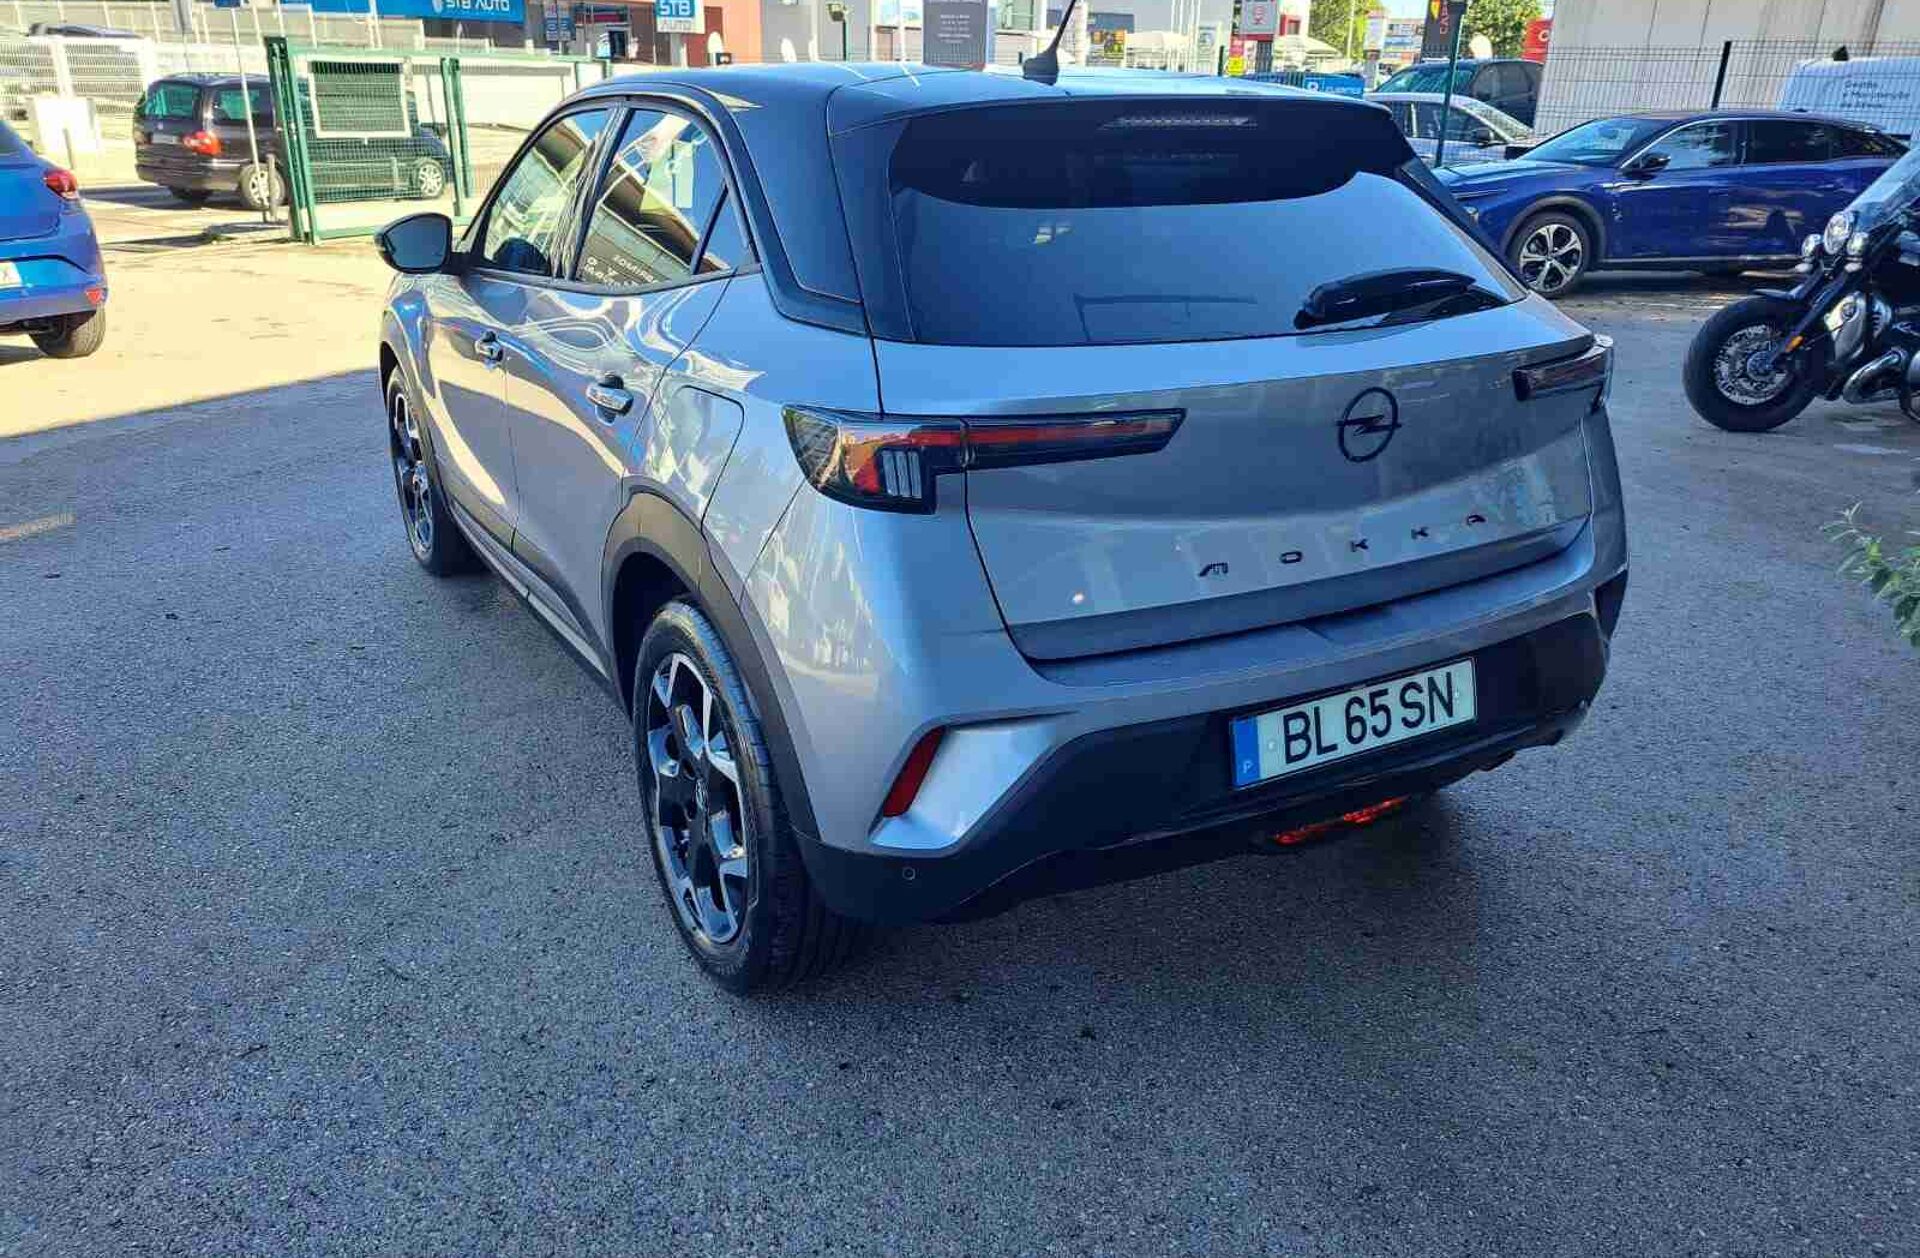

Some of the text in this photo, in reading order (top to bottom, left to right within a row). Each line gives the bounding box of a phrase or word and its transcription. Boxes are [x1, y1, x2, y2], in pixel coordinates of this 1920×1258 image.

[475, 0, 510, 12] AUTO
[659, 1, 691, 16] STB
[1199, 514, 1487, 577] MOKKA
[1283, 671, 1454, 765] BL 65 SN
